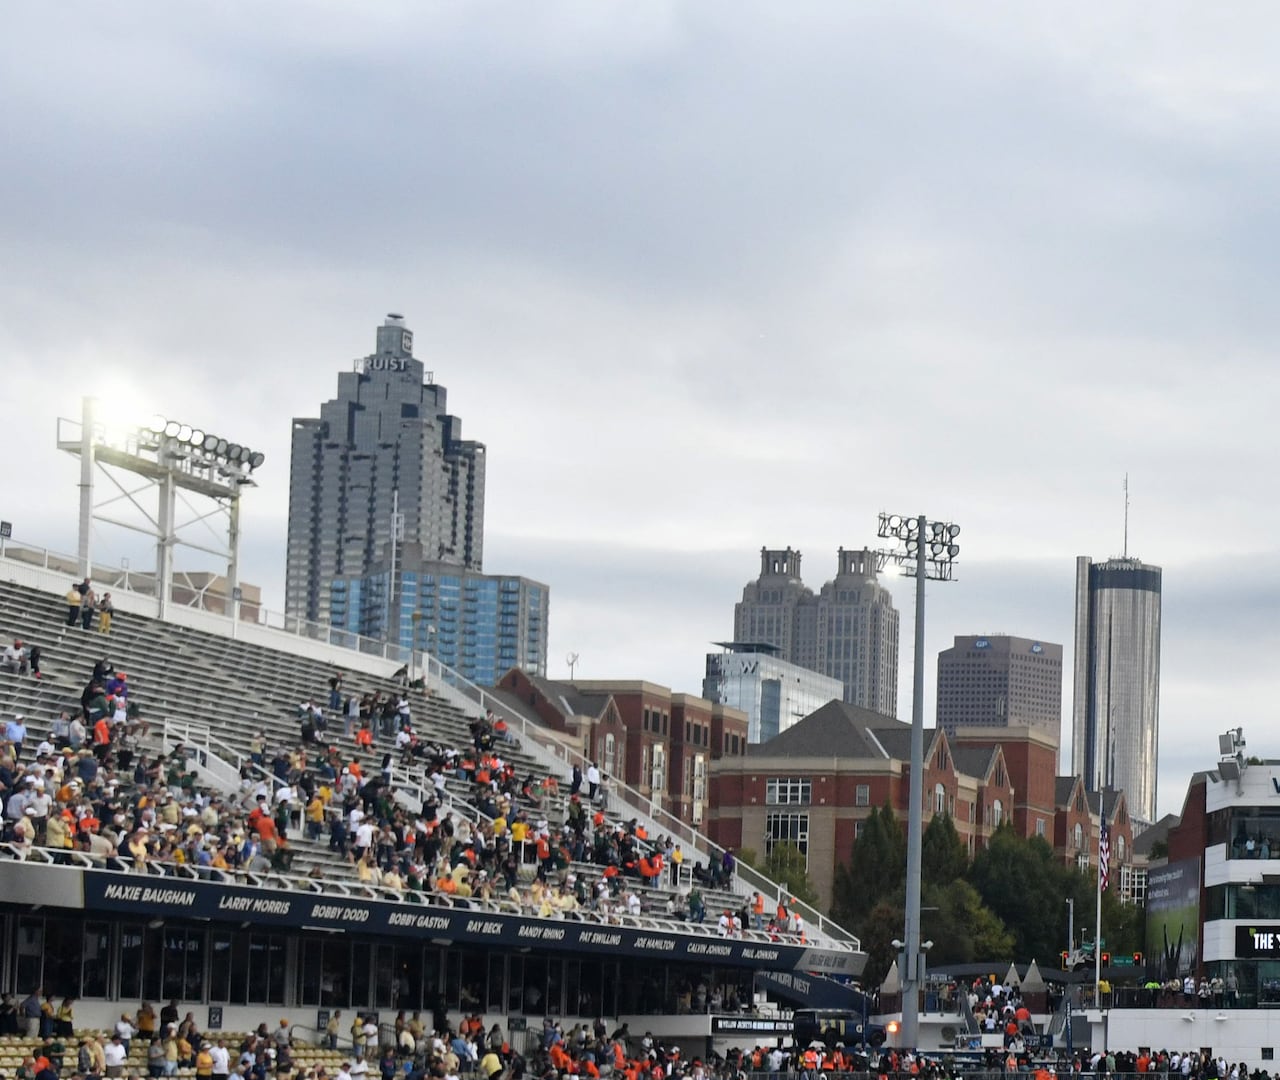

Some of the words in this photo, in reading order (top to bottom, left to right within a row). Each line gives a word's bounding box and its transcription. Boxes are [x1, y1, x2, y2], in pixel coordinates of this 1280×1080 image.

[104, 884, 141, 902] MAXIE
[142, 887, 196, 906] BAUGHAN
[219, 896, 252, 912] LARRY
[253, 899, 291, 915] MORRIS
[311, 904, 342, 920] BOBBY
[343, 907, 370, 922] DODD
[388, 912, 415, 927] BOBBY
[416, 915, 450, 930] GASTON
[466, 919, 483, 934] RAY
[484, 921, 503, 936] BECK
[519, 925, 541, 939] RANDY
[542, 927, 565, 941] RHINO
[579, 931, 590, 944] PAT
[591, 932, 621, 946] SWILLING
[634, 937, 645, 949] JOE
[645, 938, 675, 951] HAMILTON
[687, 942, 708, 954] CALVIN
[708, 944, 732, 957] JOHNSON
[1254, 933, 1274, 951] THE
[741, 948, 755, 959] PAUL
[755, 949, 779, 961] JOHNSON
[793, 977, 811, 995] NEST
